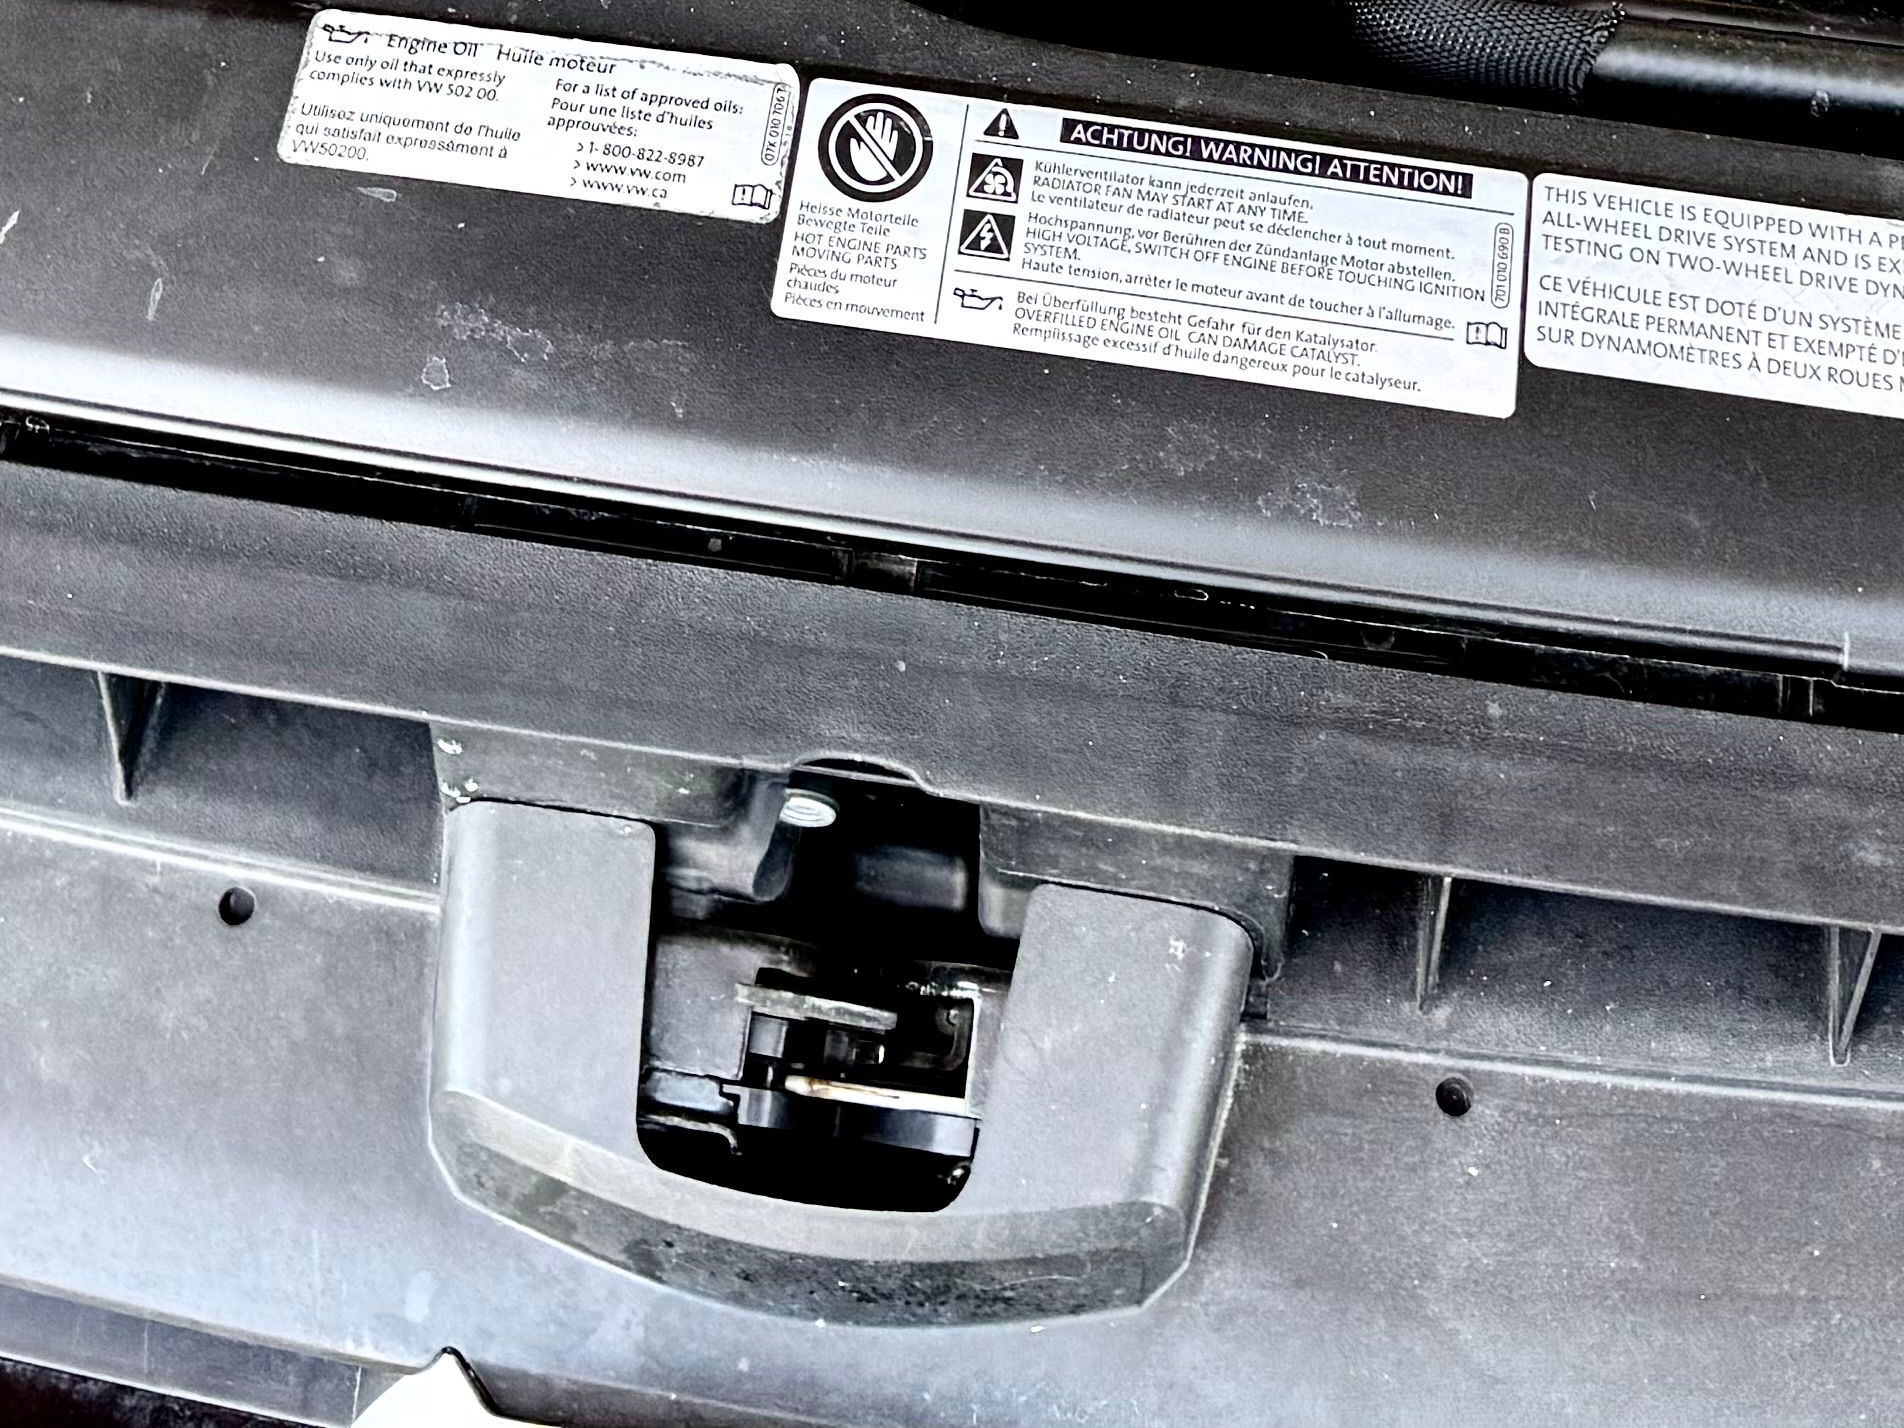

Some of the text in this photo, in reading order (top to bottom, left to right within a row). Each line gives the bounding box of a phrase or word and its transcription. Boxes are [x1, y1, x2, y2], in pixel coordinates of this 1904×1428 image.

[386, 32, 479, 58] Engine Oil
[496, 44, 619, 75] Huile moteur
[554, 77, 743, 115] For a list of approved oils:
[1069, 122, 1464, 195] ACHTUNG! WARNING! ATTENTION!
[1032, 174, 1102, 196] RADIATOR
[1104, 183, 1133, 200] FAN
[1135, 187, 1169, 205] MAY
[1171, 193, 1214, 211] START
[1214, 199, 1235, 214] AT
[1235, 202, 1267, 218] ANY
[1543, 184, 1588, 207] THIS
[1592, 191, 1674, 219] VEHICLE
[1680, 203, 1697, 222] IS
[1702, 206, 1804, 236] EQUIPPED
[1807, 221, 1863, 245] WITH
[1867, 230, 1883, 248] A
[790, 244, 898, 271] MOVING PARTS
[793, 230, 928, 261] HOT ENGINE PARTS
[1540, 232, 1624, 261] TESTING
[1628, 245, 1661, 266] ON
[1665, 250, 1794, 285] TWO-WHEEL
[1798, 268, 1859, 294] DRIVE
[1541, 209, 1653, 241] ALL-WHEEL
[1657, 224, 1717, 250] DRIVE
[1722, 234, 1796, 260] SYSTEM
[1801, 245, 1848, 267] AND
[1853, 252, 1872, 271] IS
[1538, 273, 1563, 294] CE
[1566, 275, 1663, 308] VÉHICULE
[1667, 290, 1701, 313] EST
[1704, 296, 1758, 321] DOTÉ
[1817, 312, 1902, 341] SYSTÈME
[1535, 324, 1575, 347] SUR
[1580, 330, 1743, 370] DYNAMOMÈTRES
[1746, 347, 1762, 373] À
[1766, 356, 1822, 382] DEUX
[1826, 365, 1894, 392] ROUES
[1644, 313, 1763, 347] PERMANENT
[1766, 331, 1790, 351] ET
[1793, 334, 1878, 364] EXEMPTÉ
